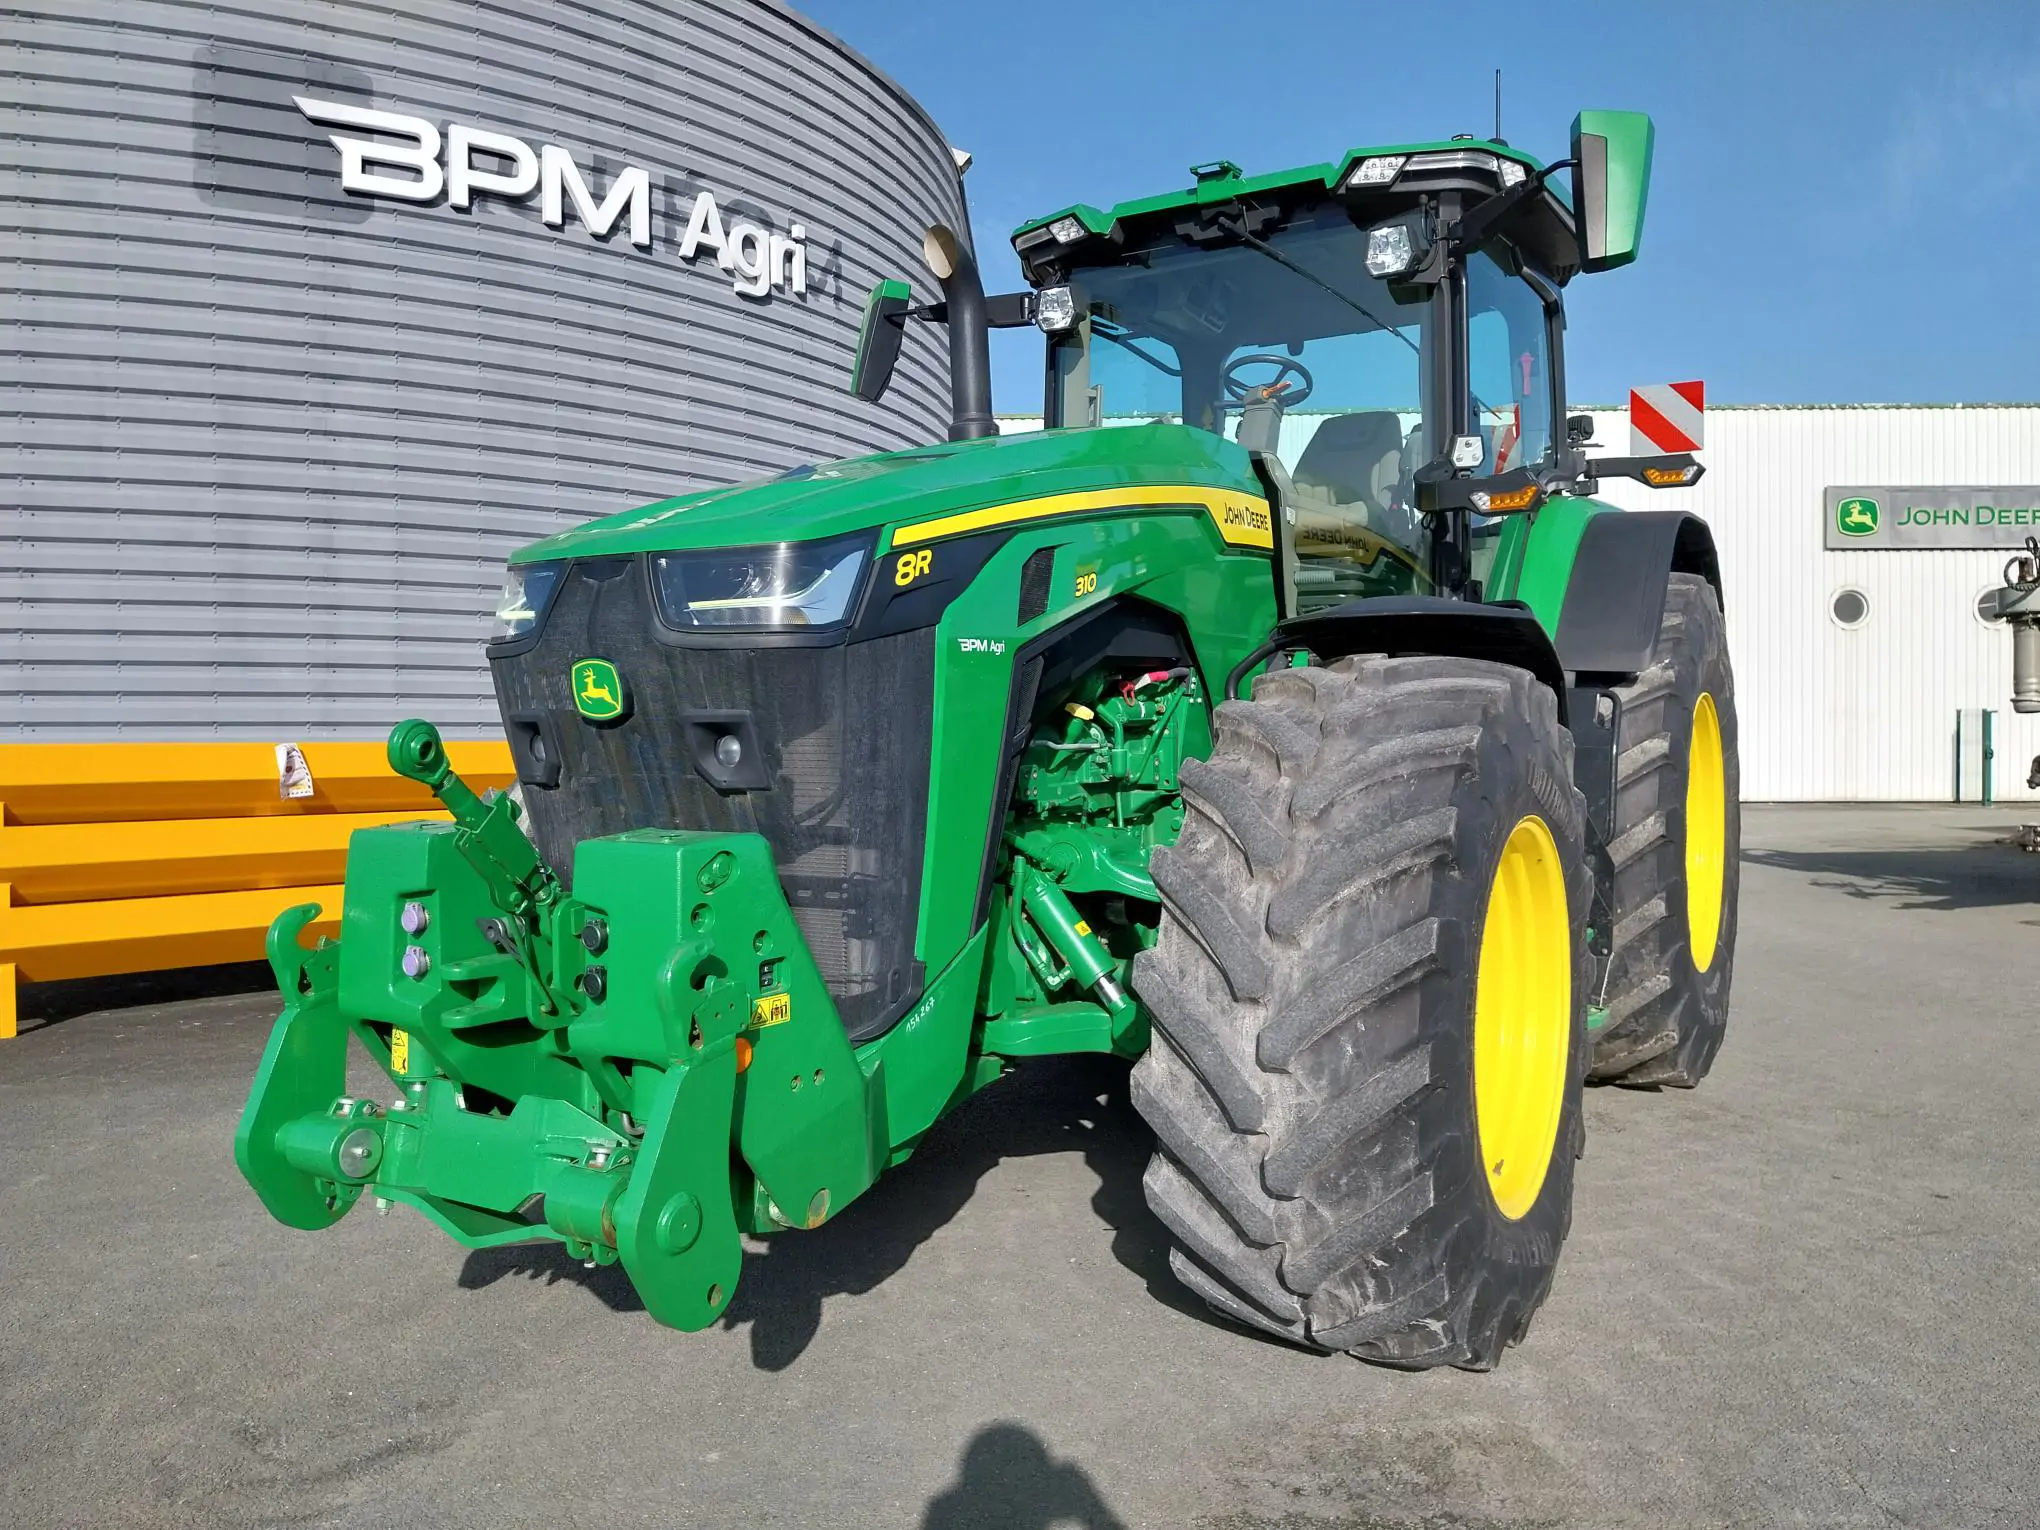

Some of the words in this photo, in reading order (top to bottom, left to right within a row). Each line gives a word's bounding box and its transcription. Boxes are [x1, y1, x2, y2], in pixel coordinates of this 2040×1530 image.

[292, 96, 650, 247] BPM
[678, 190, 807, 298] Agri
[1224, 501, 1246, 526] JOHN
[1245, 506, 1269, 531] DEERE
[1897, 506, 1969, 526] JOHN
[894, 549, 933, 587] 8R
[1075, 572, 1097, 597] 310
[957, 638, 988, 652] BPM
[989, 639, 1006, 656] Agri
